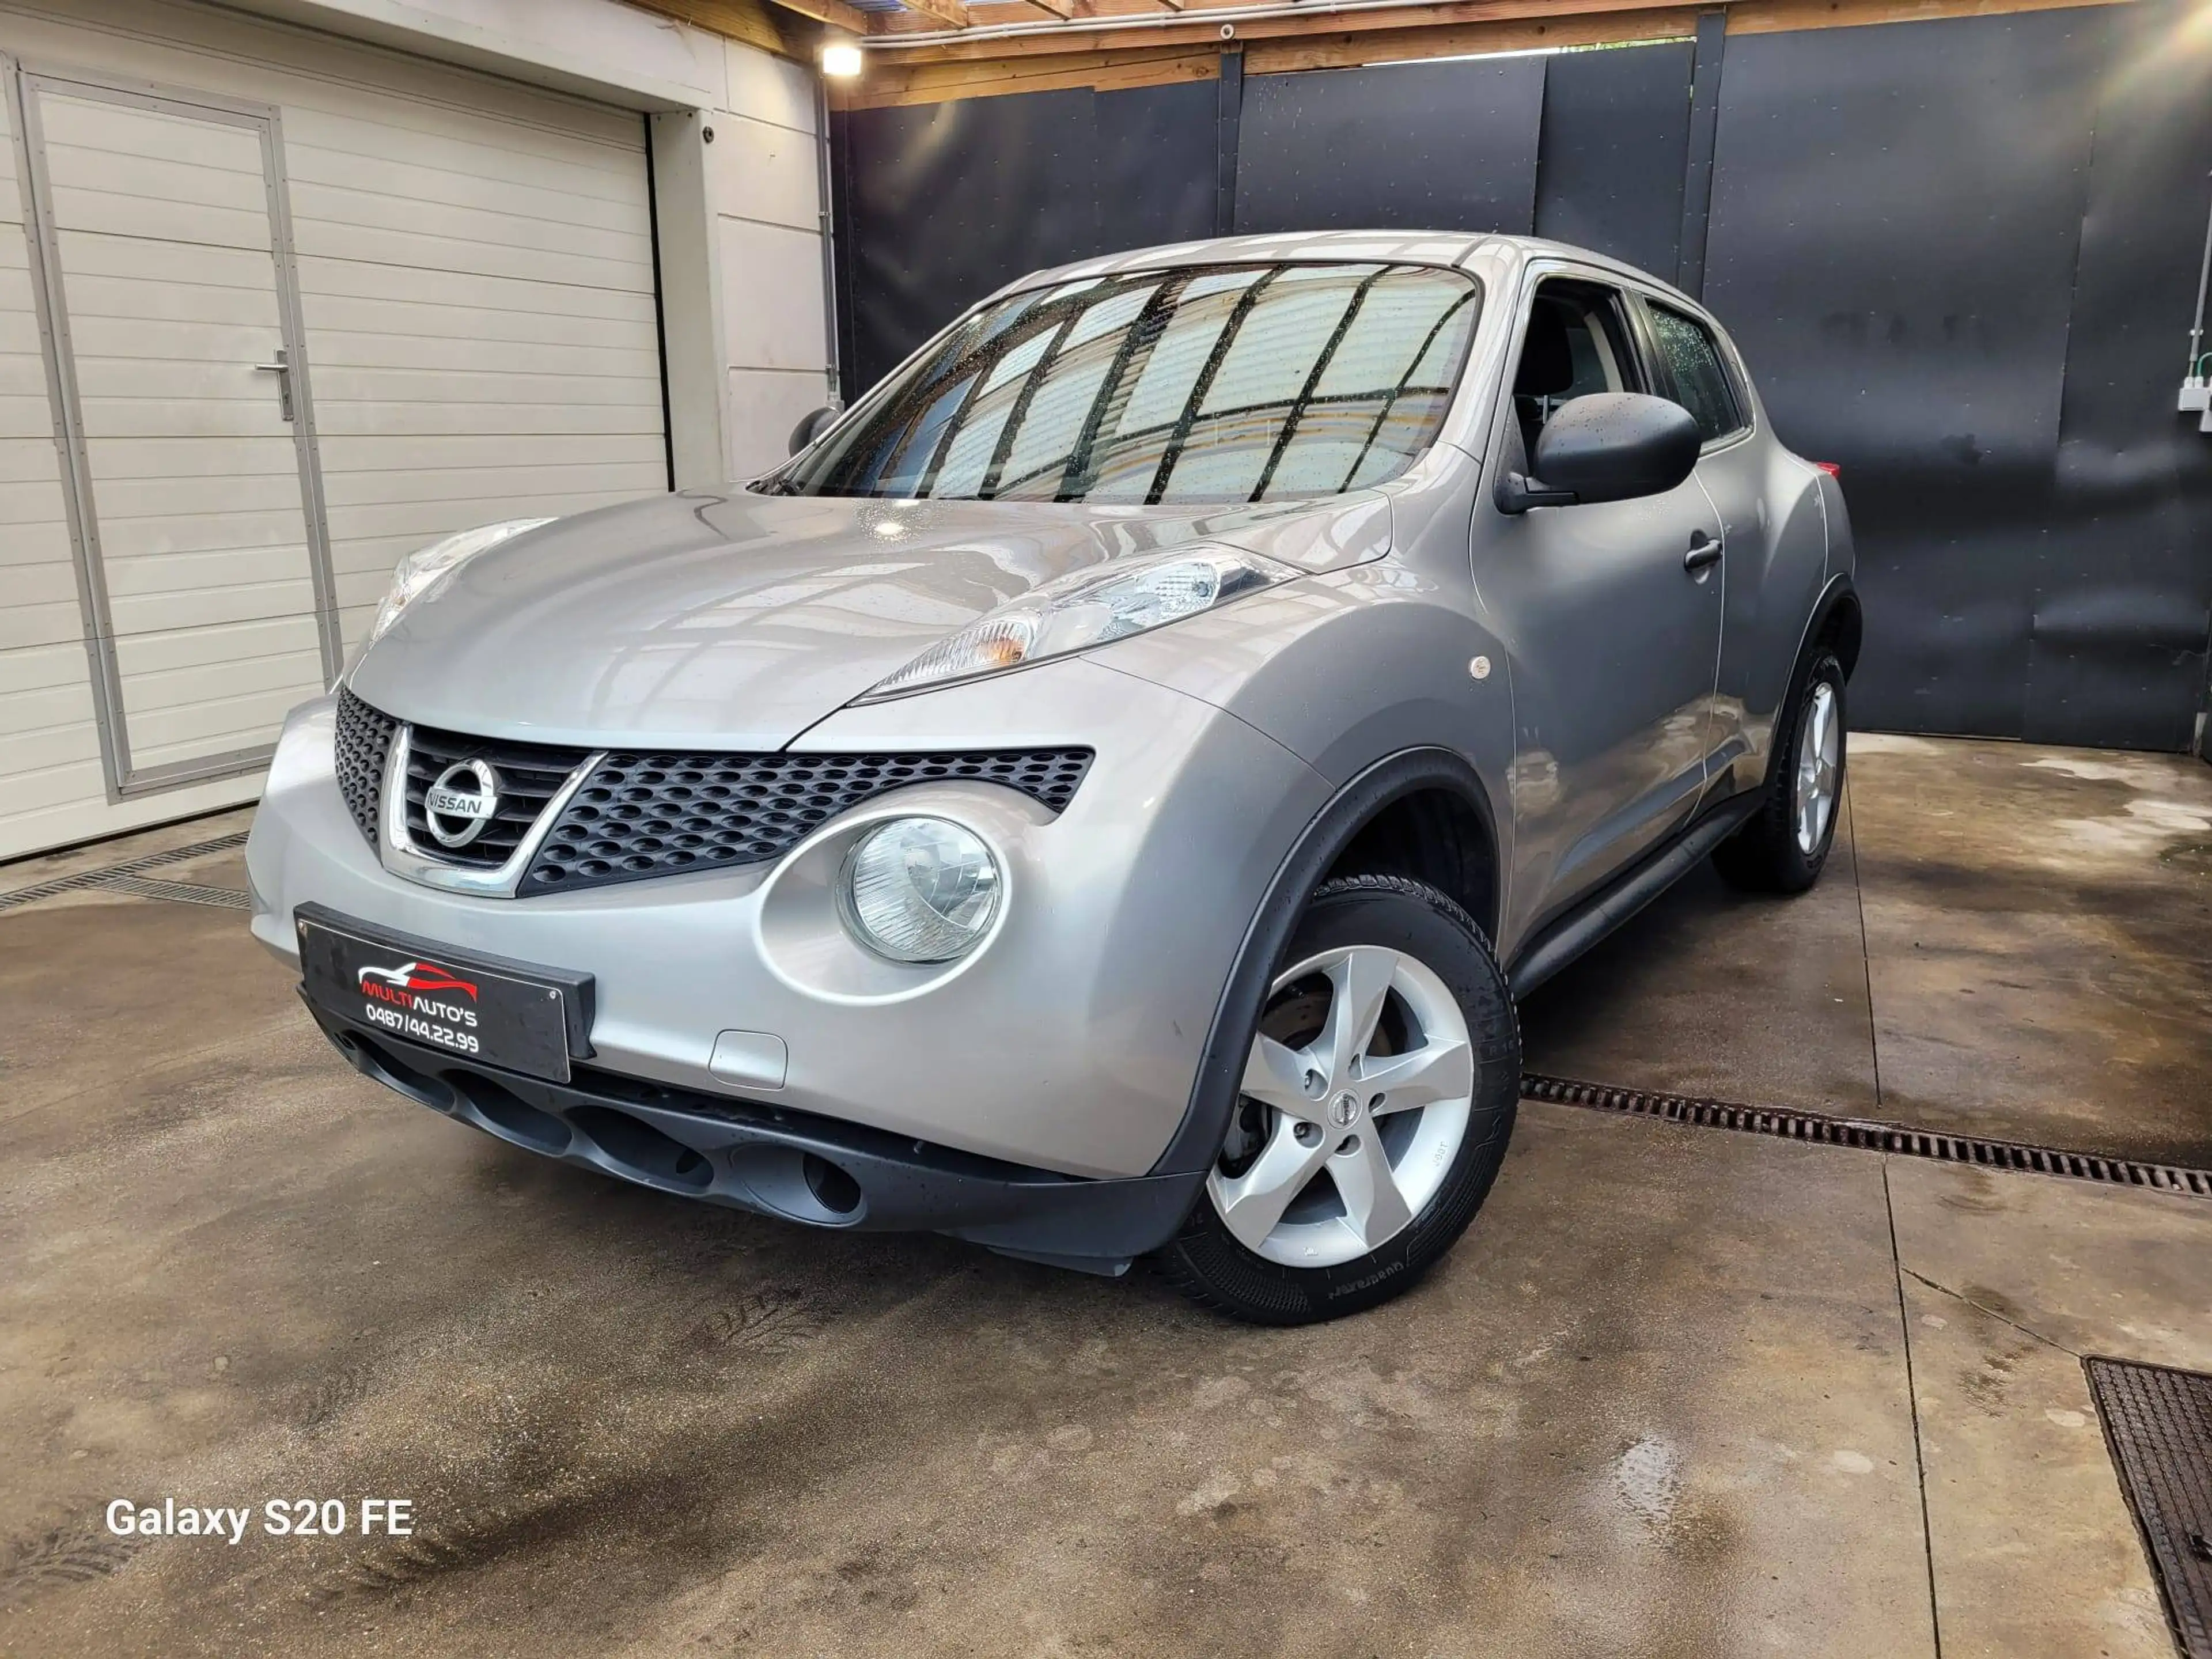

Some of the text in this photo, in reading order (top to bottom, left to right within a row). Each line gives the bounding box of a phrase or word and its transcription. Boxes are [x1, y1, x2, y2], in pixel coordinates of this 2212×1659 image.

[427, 792, 482, 814] NISSAN
[362, 980, 478, 1027] MULTIAUTO'S
[366, 1003, 479, 1053] 0487/44.22.99
